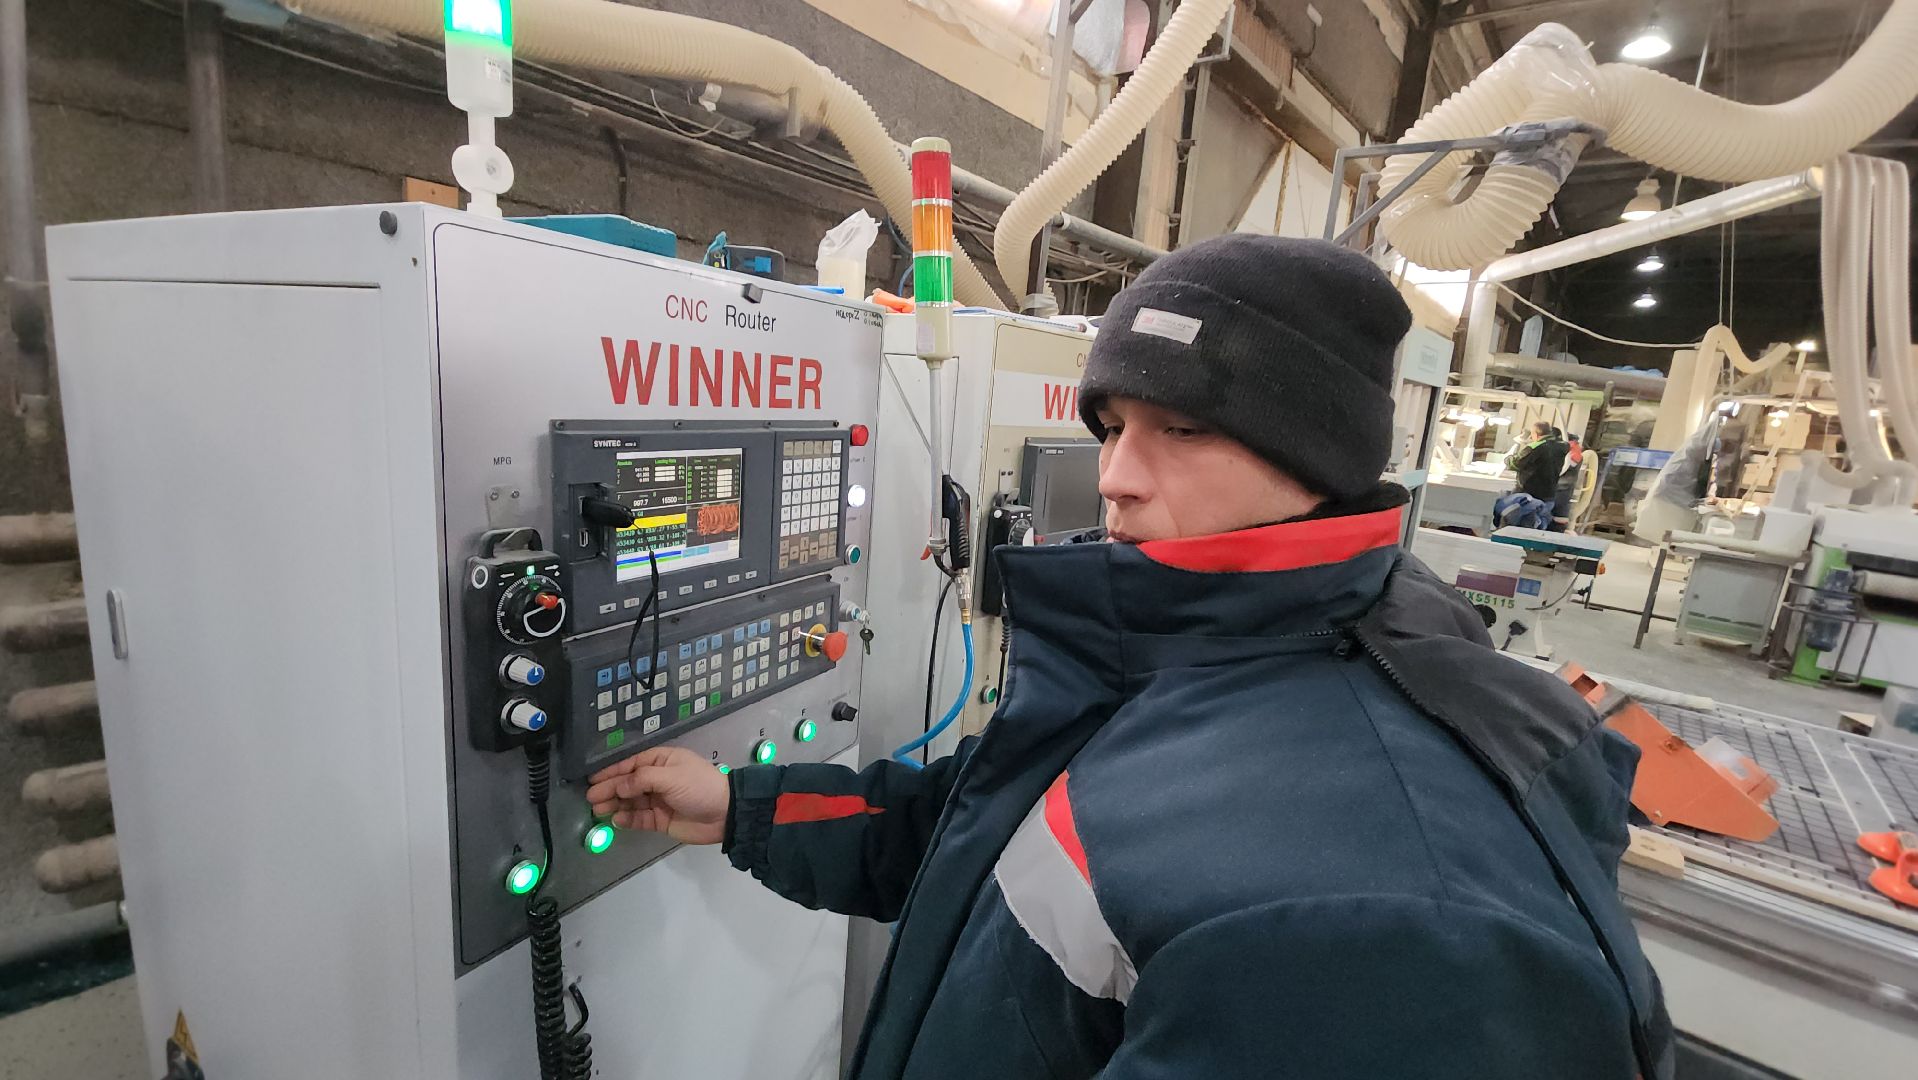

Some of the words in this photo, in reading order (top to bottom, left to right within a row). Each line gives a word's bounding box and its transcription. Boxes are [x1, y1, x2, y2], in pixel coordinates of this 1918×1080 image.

[665, 294, 708, 323] CNC
[725, 304, 777, 333] Router
[600, 336, 823, 410] WINNER
[1044, 383, 1081, 421] WI
[593, 439, 621, 448] SYNTEC
[493, 456, 512, 465] MPG
[801, 708, 807, 716] F
[759, 728, 765, 737] E
[712, 750, 718, 760] D
[513, 843, 522, 856] A
